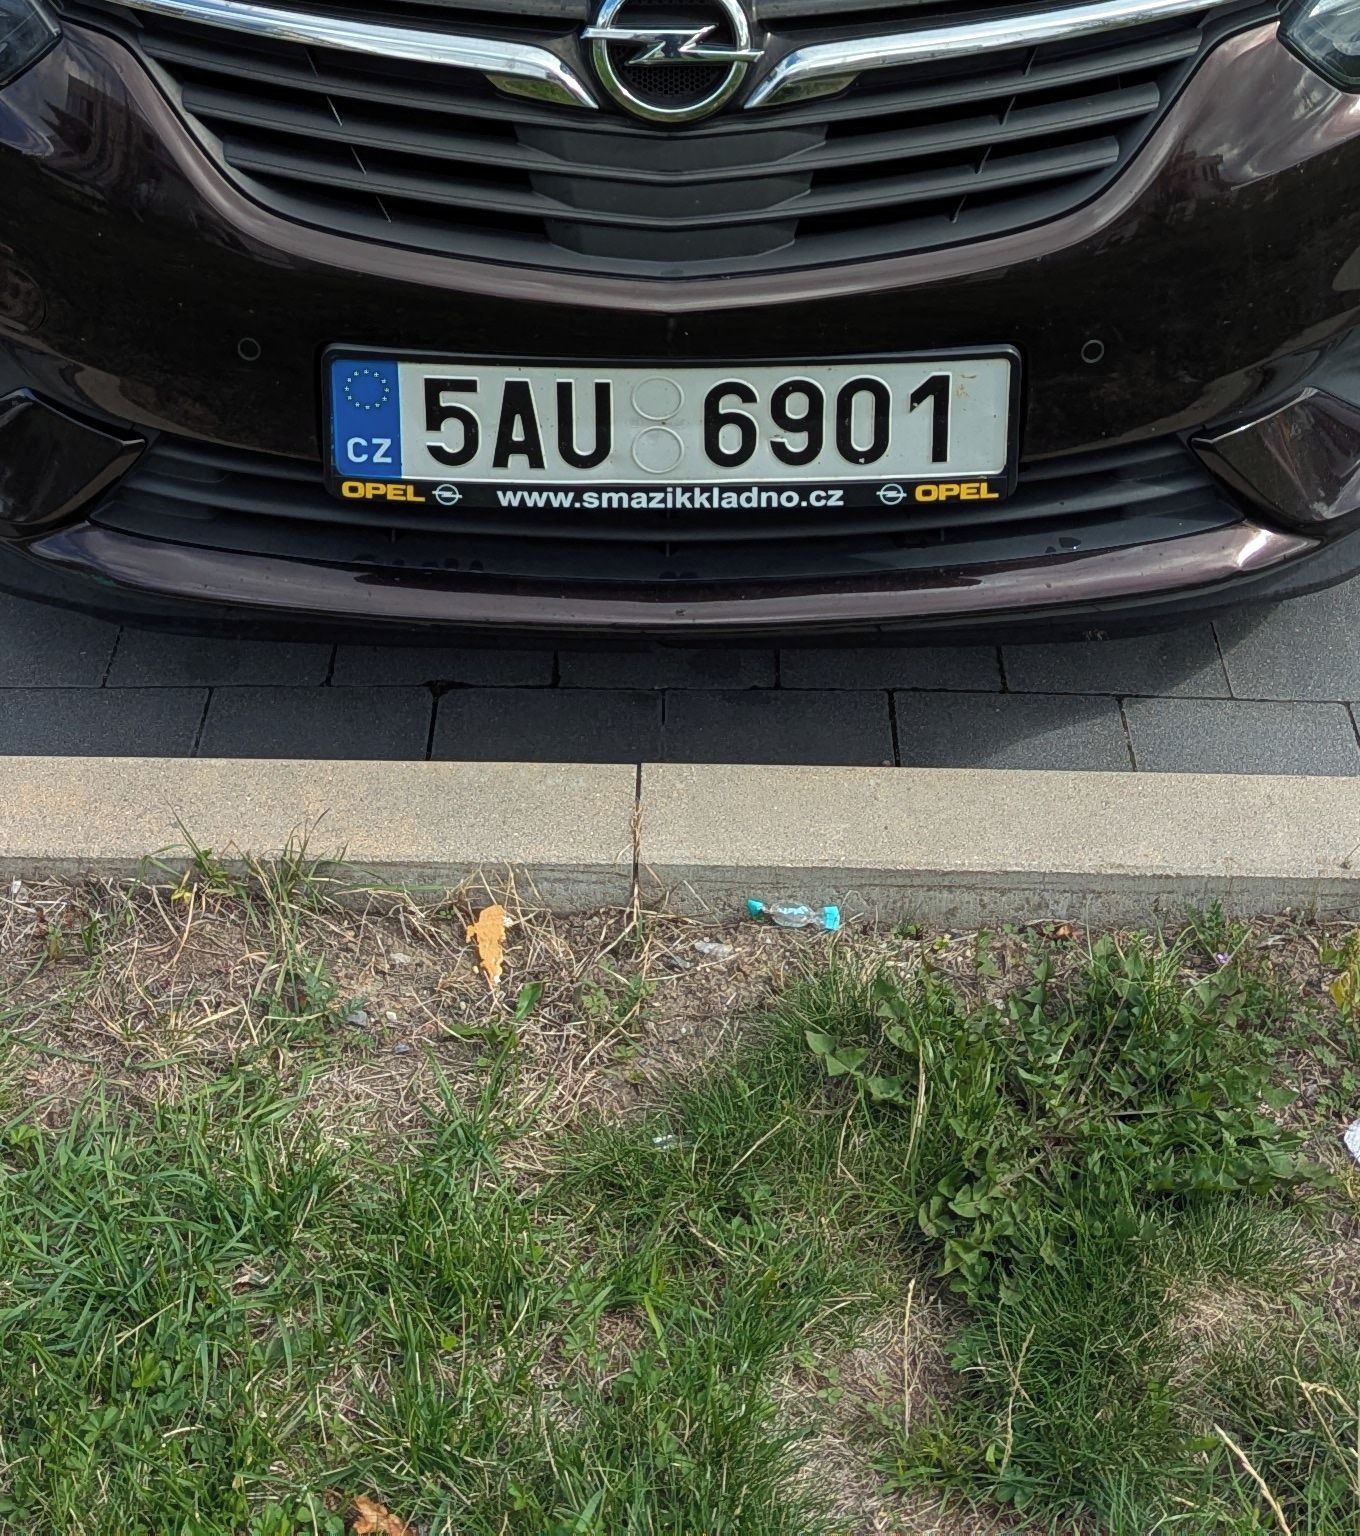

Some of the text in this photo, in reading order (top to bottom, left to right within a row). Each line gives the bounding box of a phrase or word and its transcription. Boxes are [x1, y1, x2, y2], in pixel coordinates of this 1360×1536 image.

[424, 373, 952, 470] 5AU 6901
[346, 436, 392, 464] CZ
[341, 480, 426, 502] OPEL
[496, 486, 844, 510] www.smazikkladno.cz
[914, 482, 999, 502] OPEL
